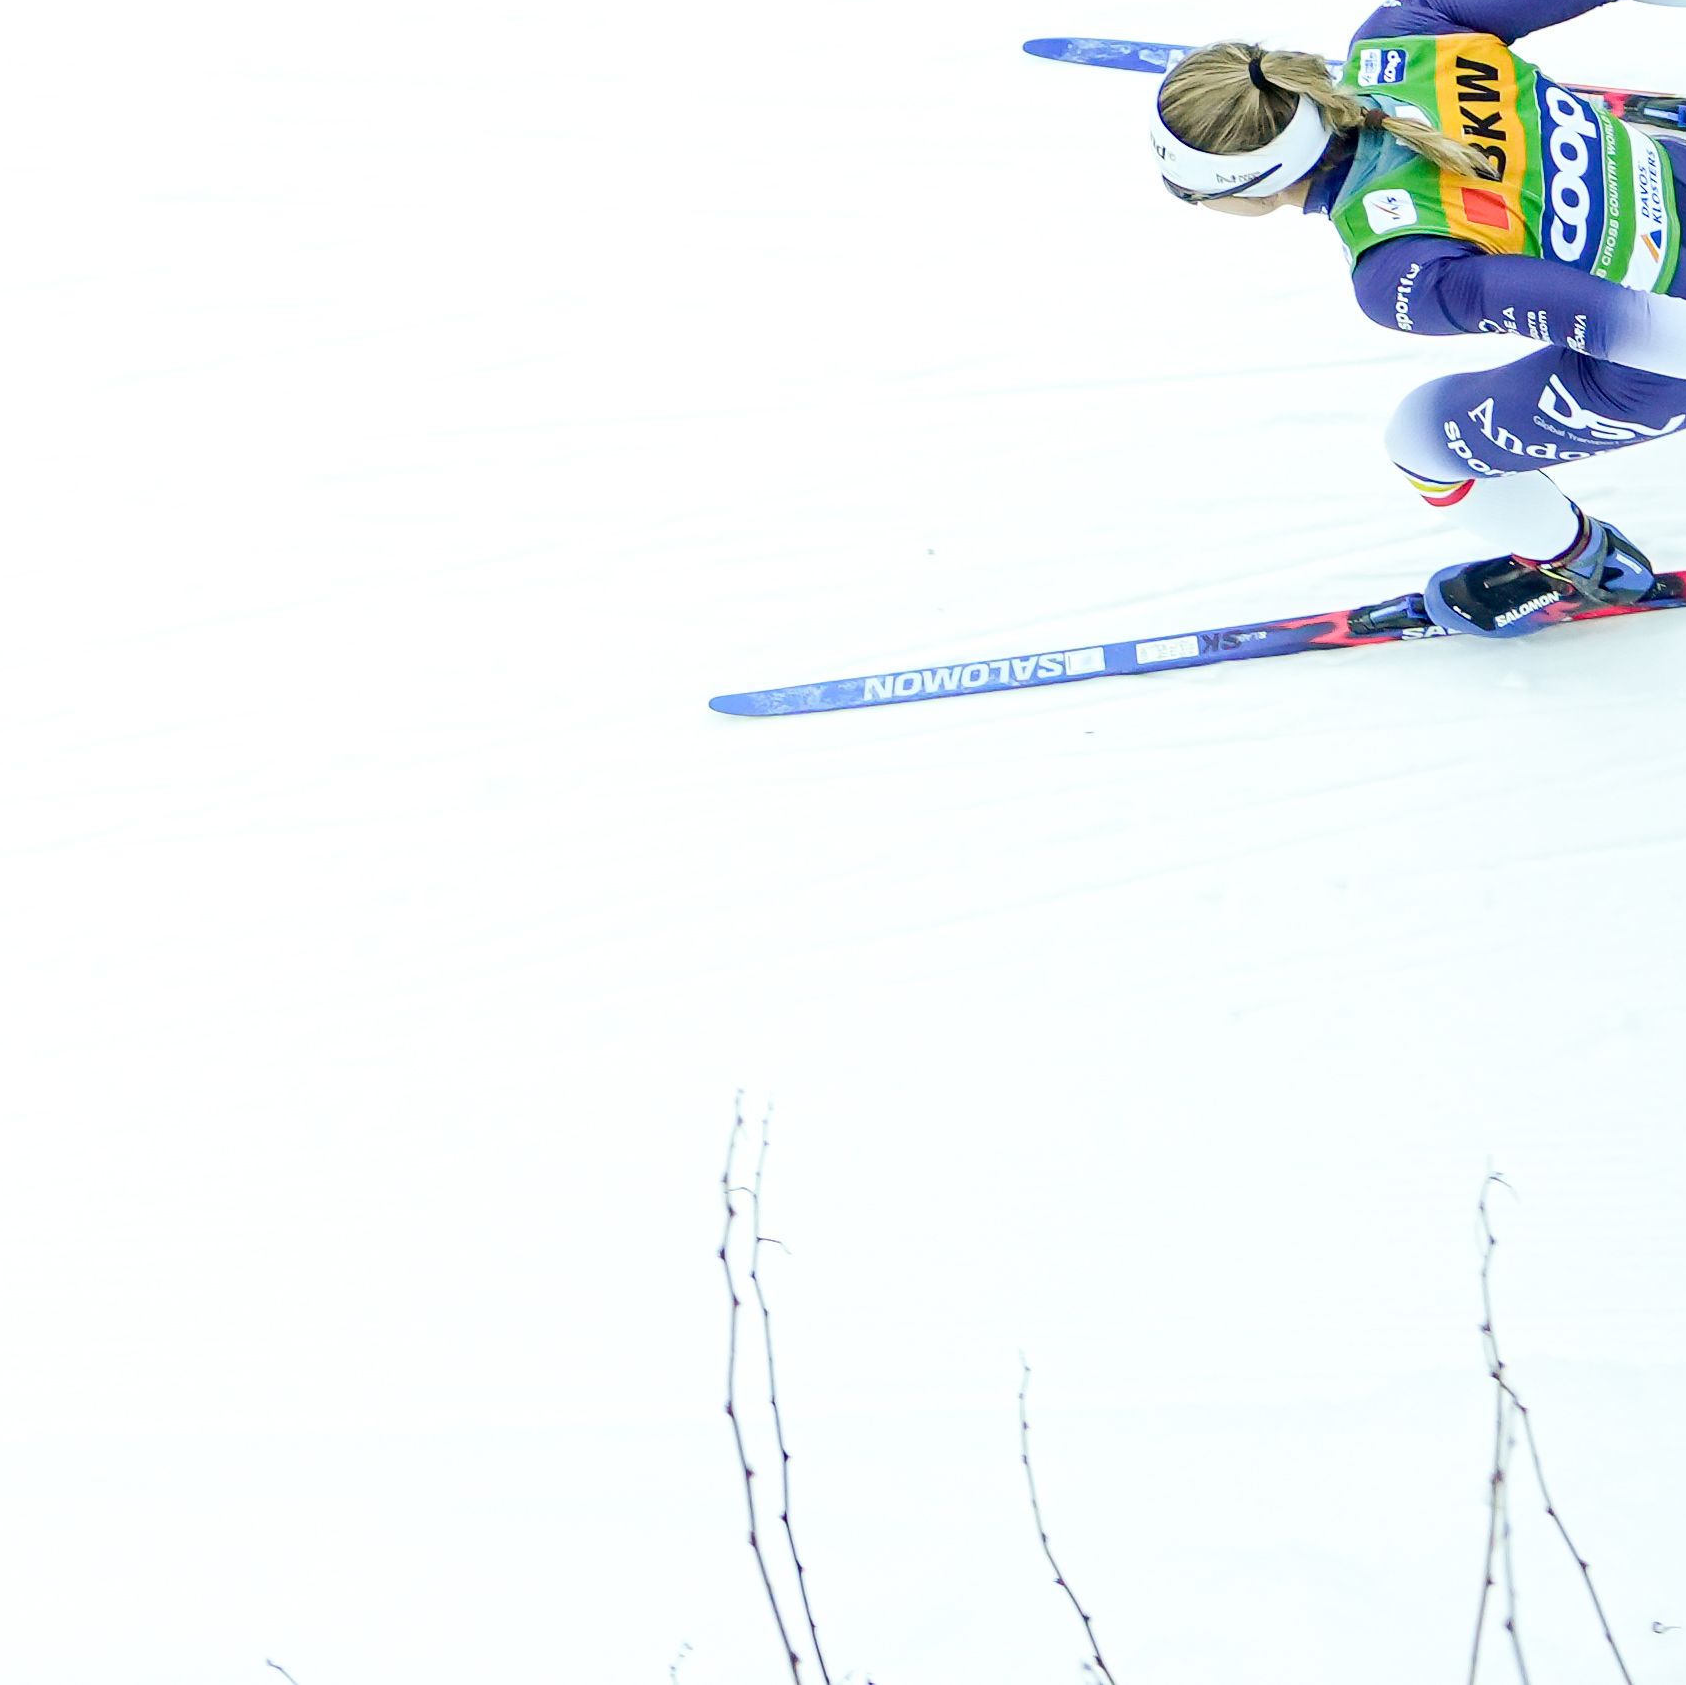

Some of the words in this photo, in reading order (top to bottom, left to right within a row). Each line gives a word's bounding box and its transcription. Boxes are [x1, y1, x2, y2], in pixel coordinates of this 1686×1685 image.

[1455, 55, 1507, 183] BKW
[1545, 86, 1598, 262] coop
[1606, 156, 1619, 217] COUNTRY
[1639, 165, 1650, 218] DAVOS
[1646, 150, 1663, 225] KLOSTERS
[1601, 219, 1619, 266] CROSS
[1395, 262, 1420, 331] sportfu
[1468, 397, 1607, 461] Ando
[1532, 415, 1566, 437] Global
[1494, 590, 1562, 628] SALOMON
[863, 652, 1065, 702] SALOMON
